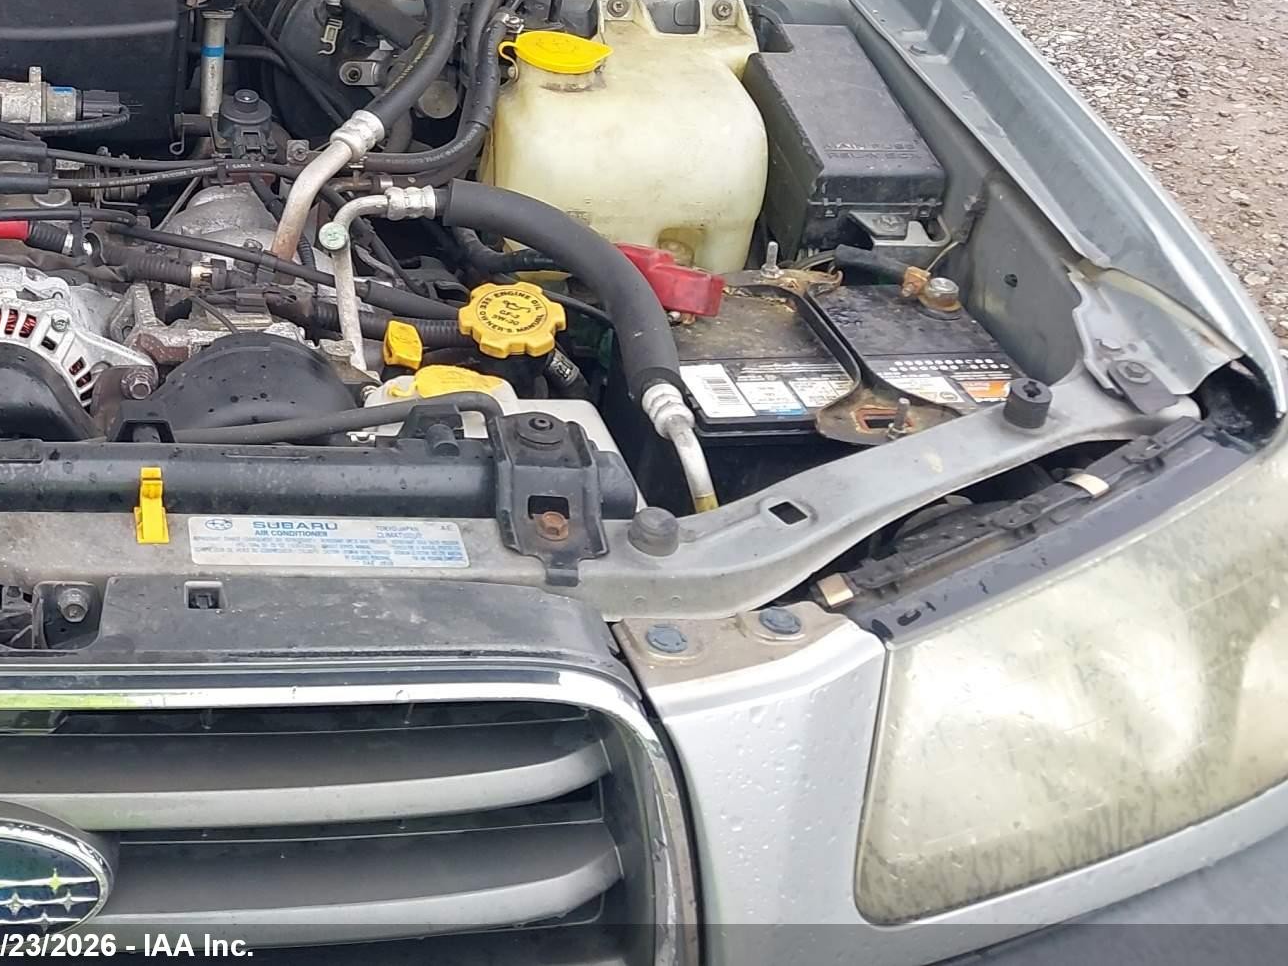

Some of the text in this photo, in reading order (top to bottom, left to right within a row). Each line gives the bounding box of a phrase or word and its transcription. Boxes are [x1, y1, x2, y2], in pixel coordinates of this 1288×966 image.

[493, 291, 544, 311] ENGINE OIL
[479, 297, 492, 310] SEE
[516, 314, 546, 333] MANUAL
[252, 521, 337, 530] SUBARU
[270, 530, 328, 538] CONDITIONER
